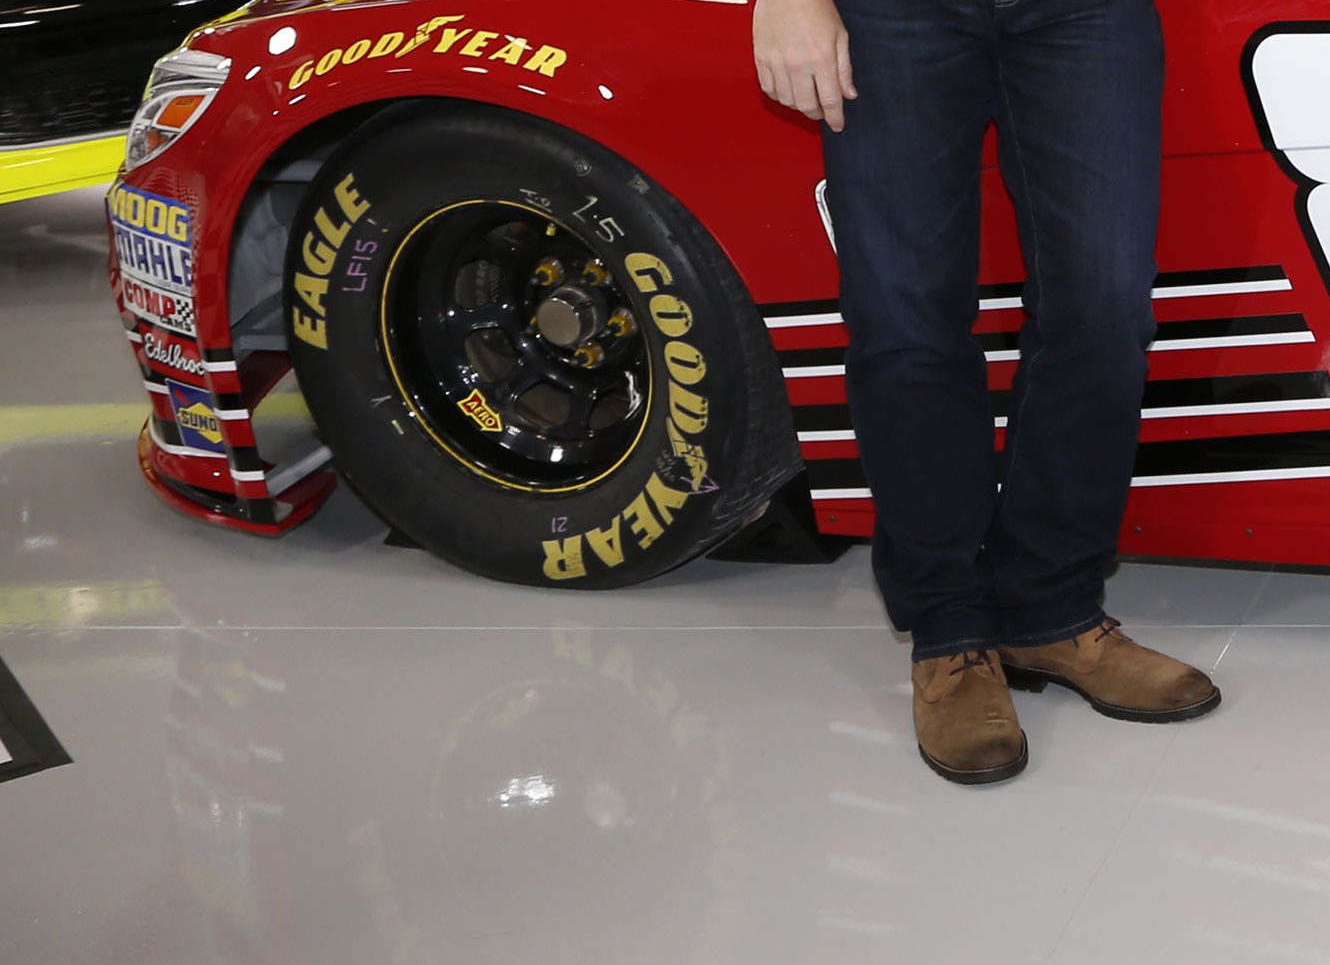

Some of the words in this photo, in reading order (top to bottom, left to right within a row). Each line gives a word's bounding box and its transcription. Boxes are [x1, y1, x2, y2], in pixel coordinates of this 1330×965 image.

[288, 15, 567, 90] GOODYEAR
[109, 182, 188, 242] MOOG
[115, 227, 191, 288] MAHLE
[293, 172, 371, 350] EAGLE
[123, 278, 176, 318] COMP
[160, 315, 193, 332] CAMS
[144, 332, 206, 375] Edelbroc
[180, 409, 218, 433] SUNO
[466, 399, 496, 427] AERO
